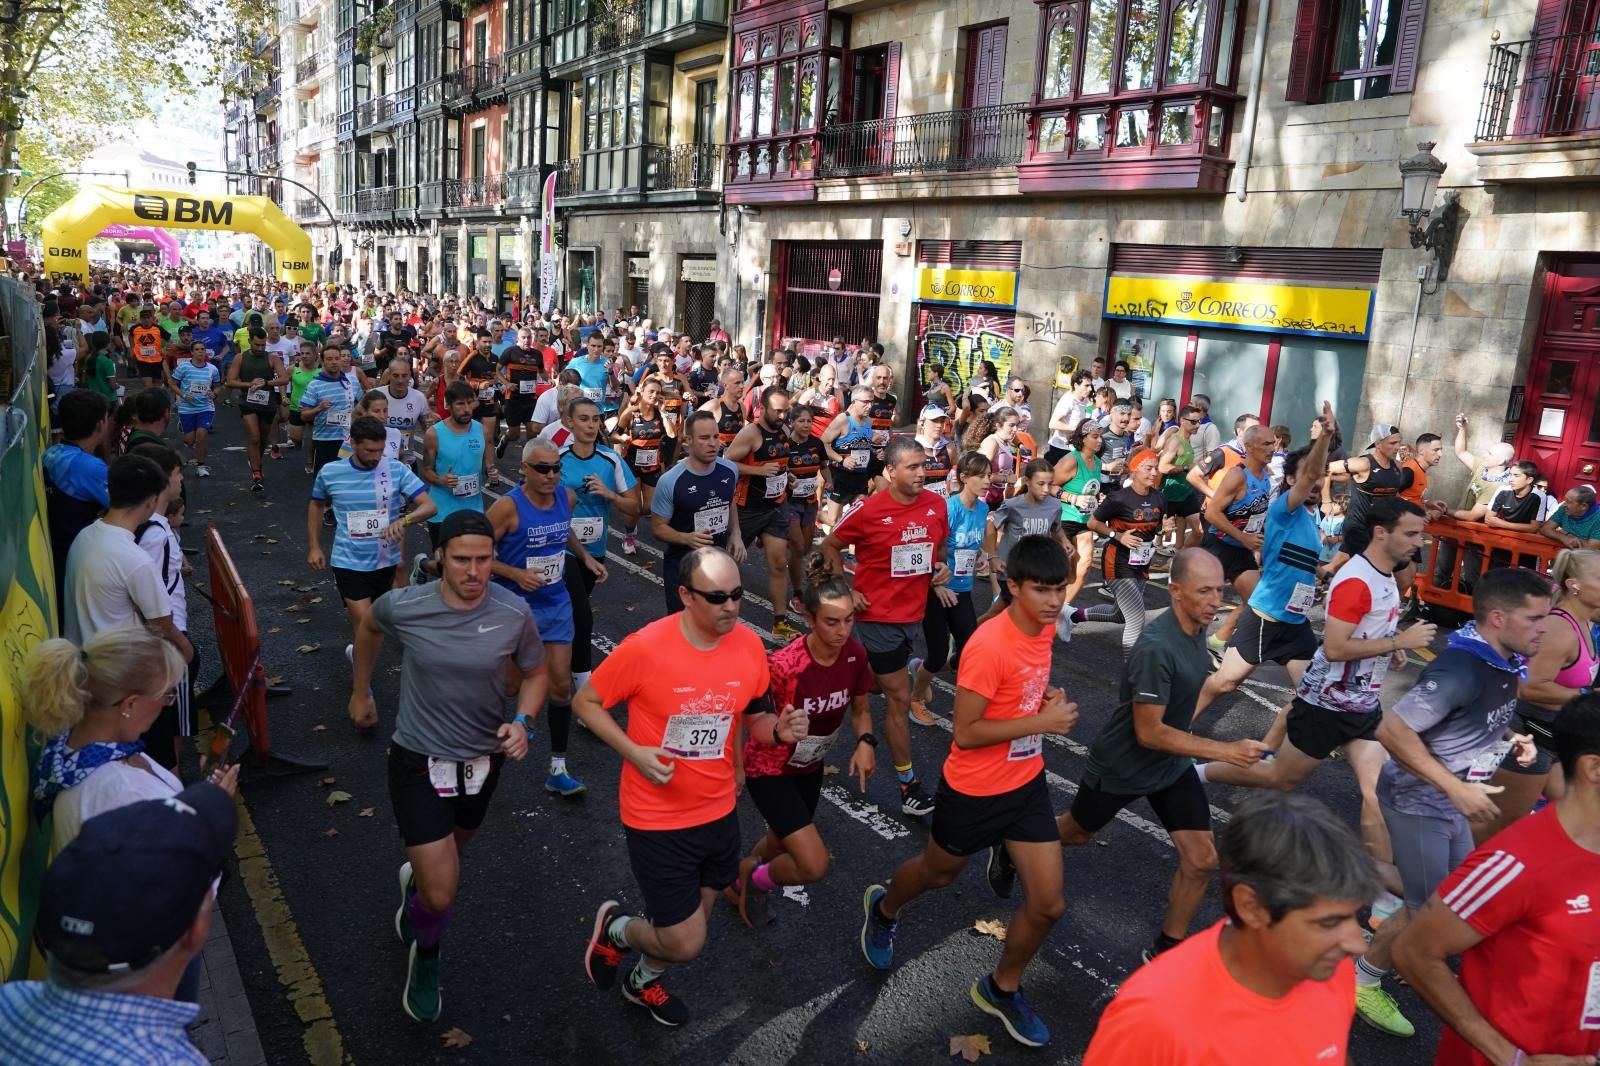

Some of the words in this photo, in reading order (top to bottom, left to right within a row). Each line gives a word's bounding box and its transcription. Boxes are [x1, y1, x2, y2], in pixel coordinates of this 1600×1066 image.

[174, 198, 233, 225] BM
[61, 248, 82, 258] BM
[293, 262, 309, 270] BM
[945, 280, 996, 299] CORREOS
[1198, 296, 1278, 320] CORREOS
[464, 480, 477, 490] 615
[366, 519, 379, 529] 80
[709, 515, 723, 527] 324
[583, 526, 594, 536] 29
[911, 553, 923, 565] 88
[544, 563, 560, 576] 571
[689, 729, 718, 746] 379
[466, 764, 473, 780] 8
